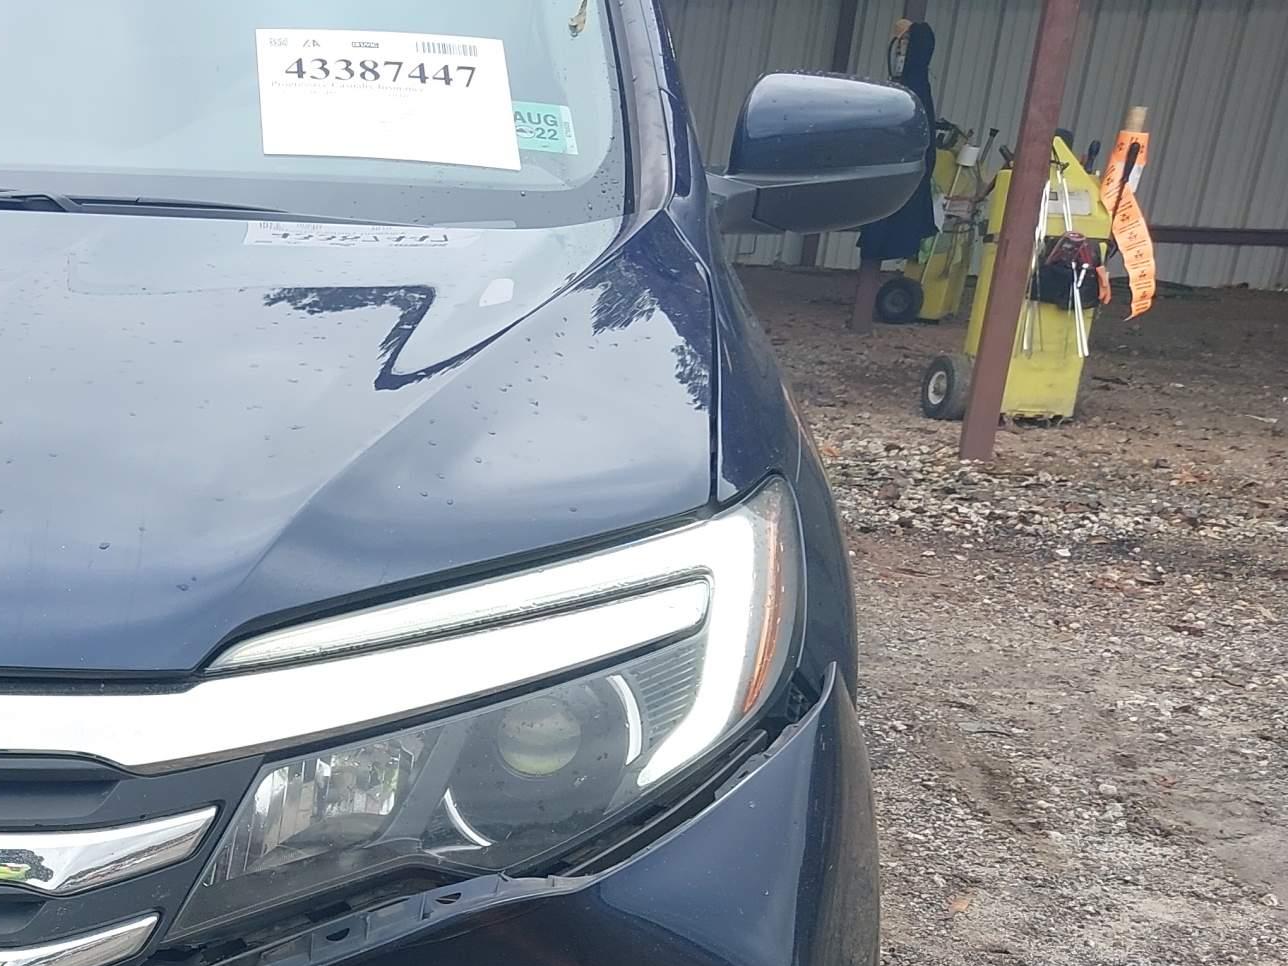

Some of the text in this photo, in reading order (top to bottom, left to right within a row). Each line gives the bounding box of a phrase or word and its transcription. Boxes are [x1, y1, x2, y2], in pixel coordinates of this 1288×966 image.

[285, 57, 477, 88] 43387447
[514, 111, 559, 127] AUG
[534, 127, 560, 141] 22
